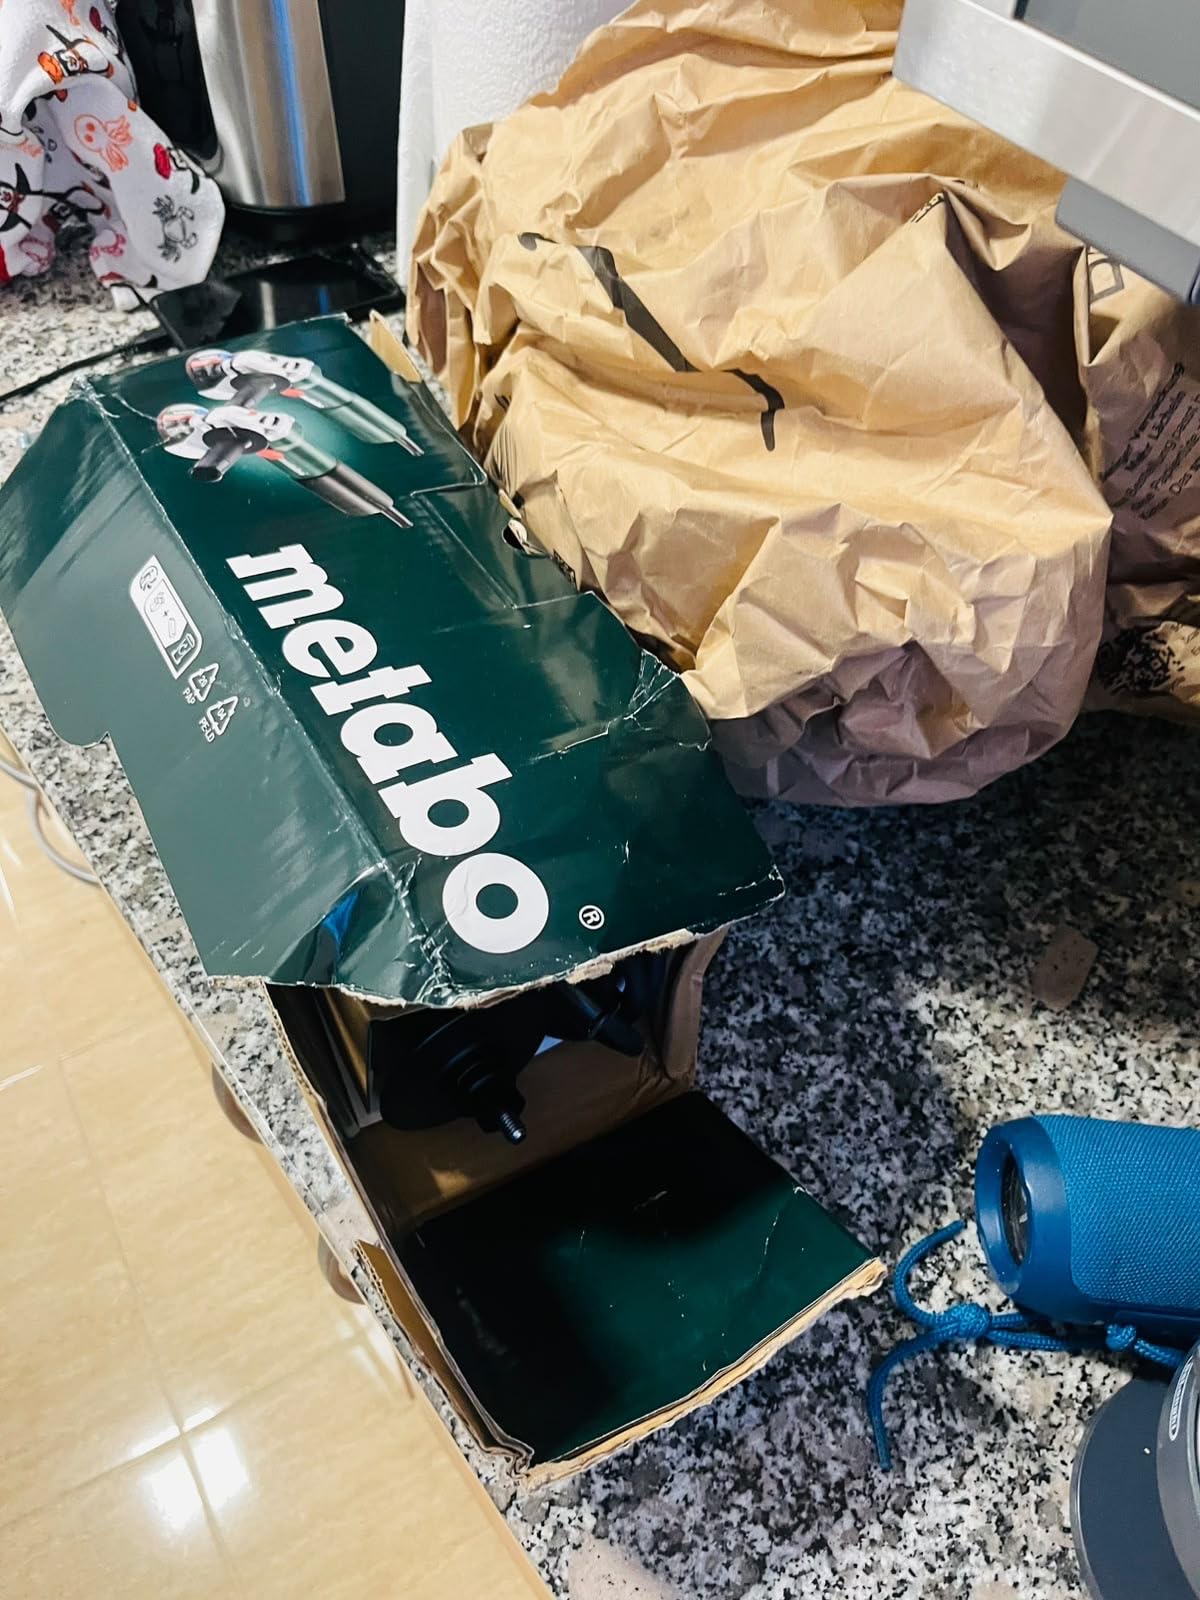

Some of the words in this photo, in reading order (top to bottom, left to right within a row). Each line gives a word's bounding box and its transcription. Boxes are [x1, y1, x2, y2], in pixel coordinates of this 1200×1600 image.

[1169, 472, 1193, 495] Das
[182, 687, 196, 705] PAP
[225, 543, 550, 954] metabo
